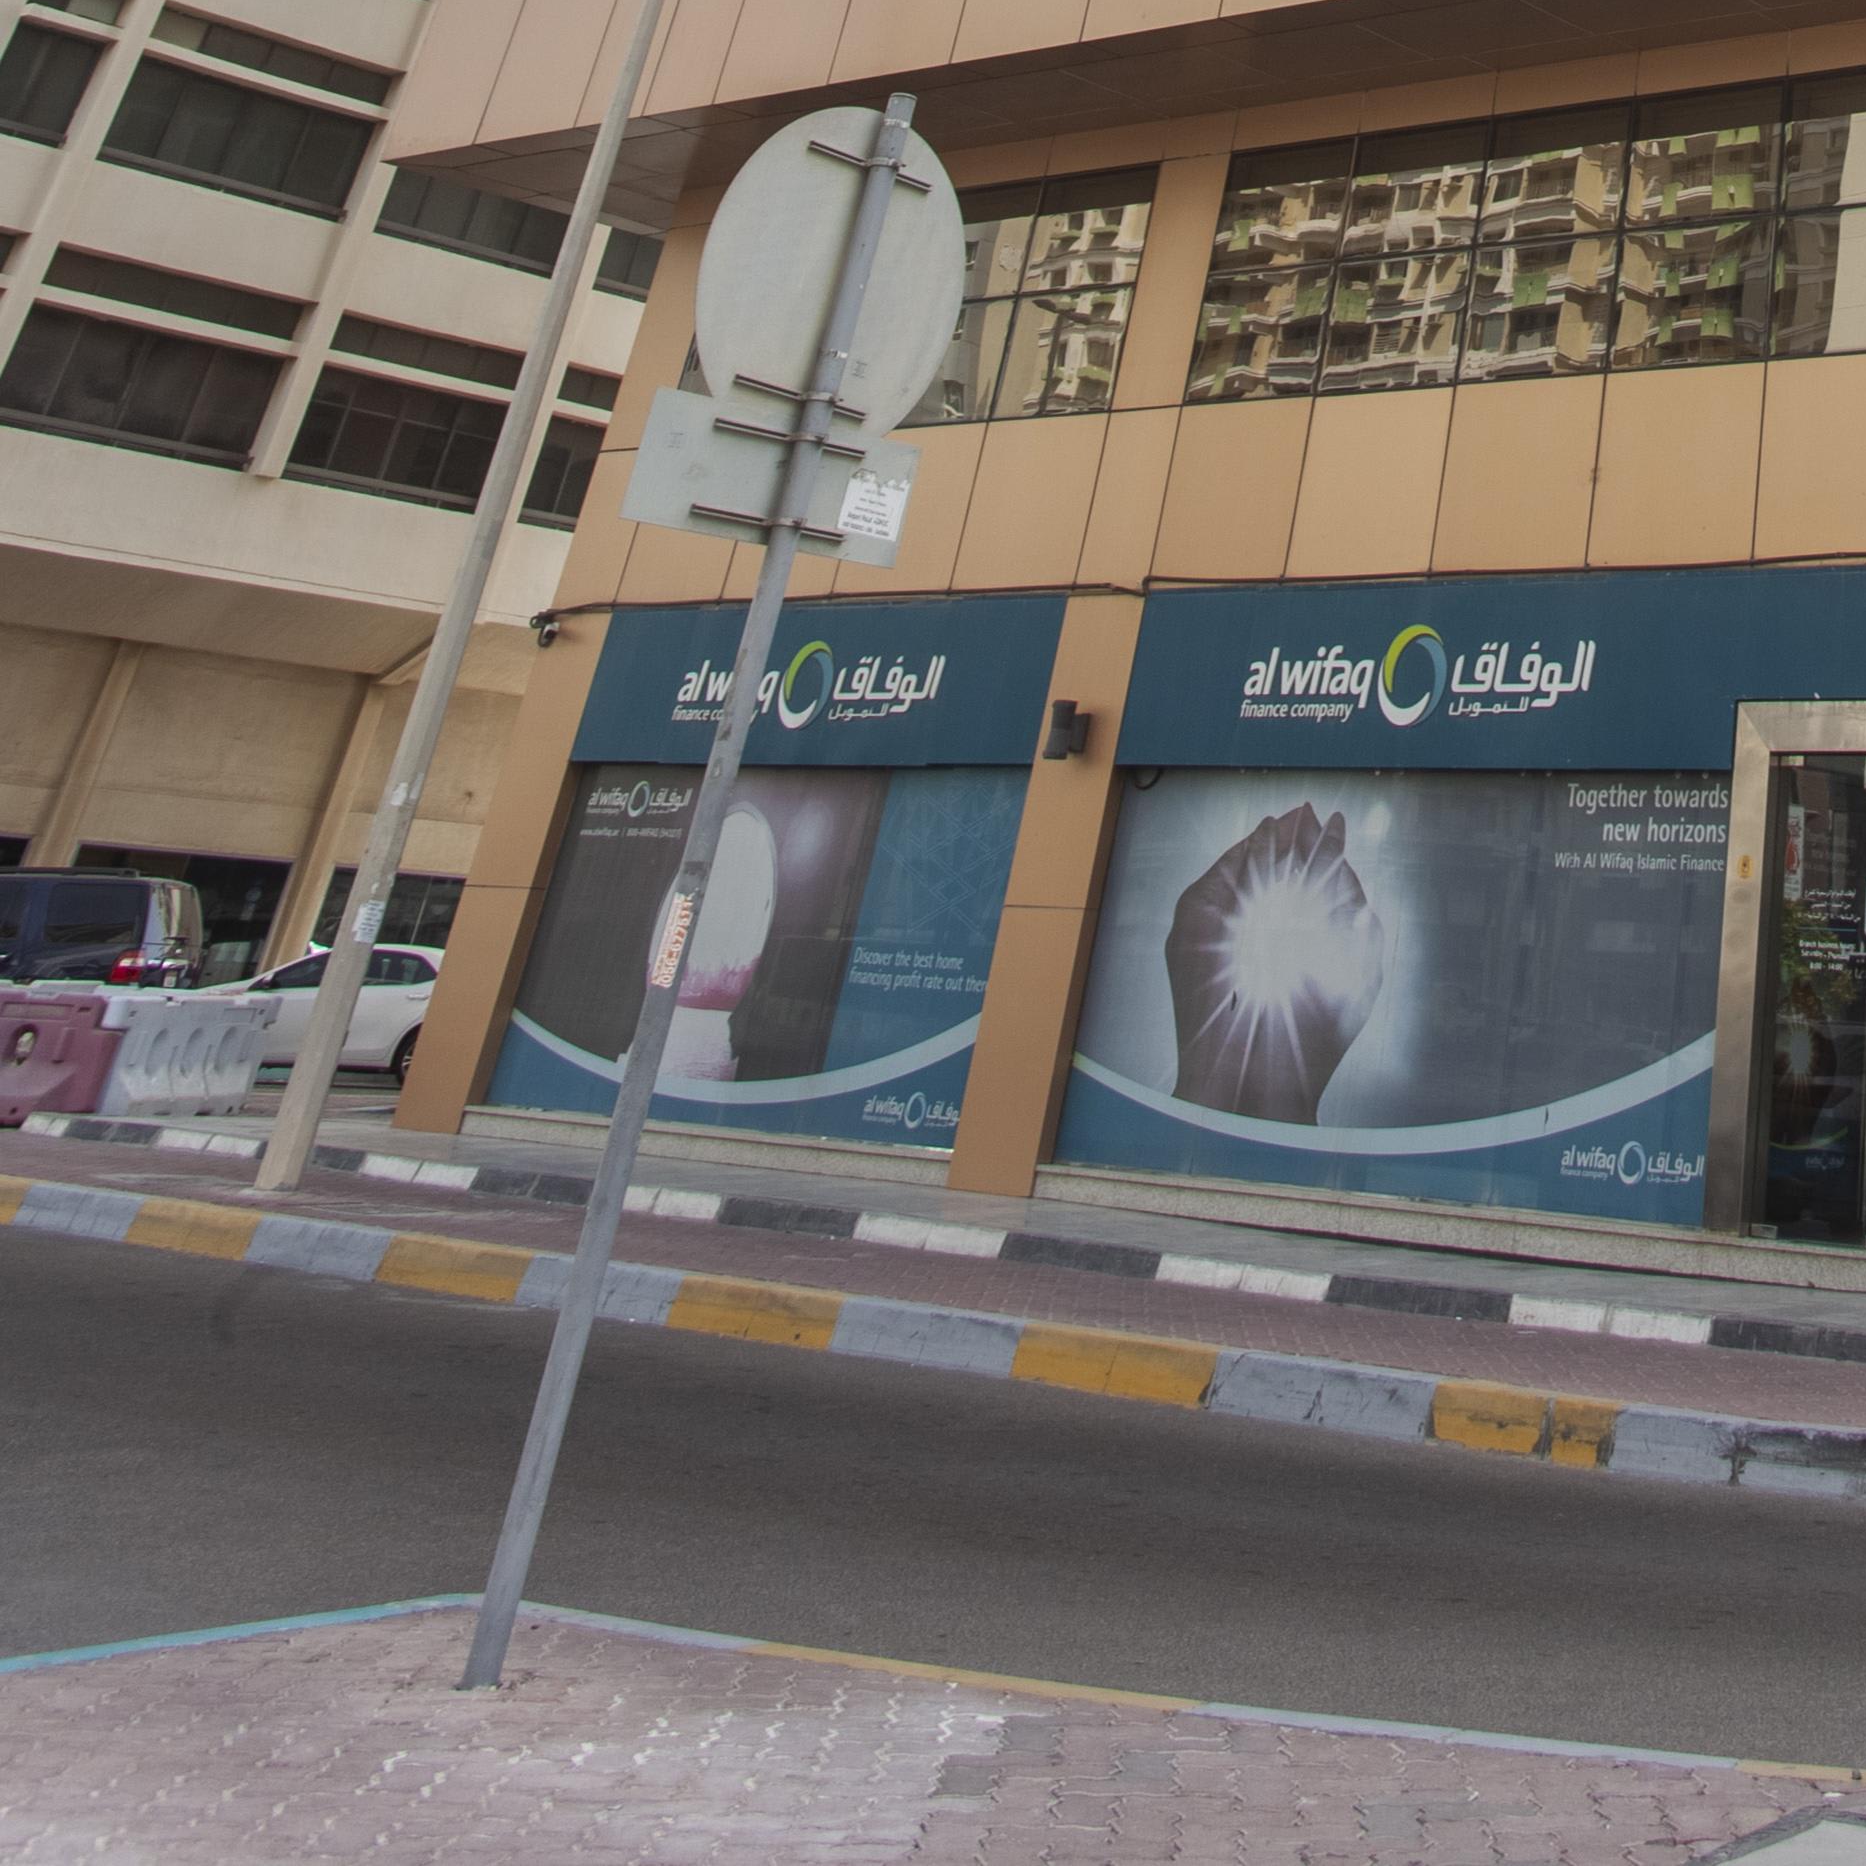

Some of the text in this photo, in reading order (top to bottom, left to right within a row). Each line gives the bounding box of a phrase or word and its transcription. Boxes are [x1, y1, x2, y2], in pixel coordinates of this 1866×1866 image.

[677, 660, 710, 702] al
[833, 655, 946, 712] الوفاق
[1243, 645, 1375, 709] al wifaq
[1451, 640, 1596, 708] الوفاق
[672, 705, 710, 721] finance
[1240, 699, 1354, 723] finance company
[1568, 783, 1729, 814] Together towards
[1602, 817, 1726, 843] new horizons
[1600, 852, 1634, 873] Wifaq
[1637, 853, 1677, 870] Islamic
[1680, 854, 1725, 872] Finance
[853, 947, 964, 970] Discover the best home
[849, 966, 893, 991] financing
[893, 970, 922, 990] profit
[923, 974, 944, 990] rate
[945, 976, 964, 991] out
[1561, 1144, 1616, 1176] al wifaq
[1647, 1151, 1705, 1182] الوفاق
